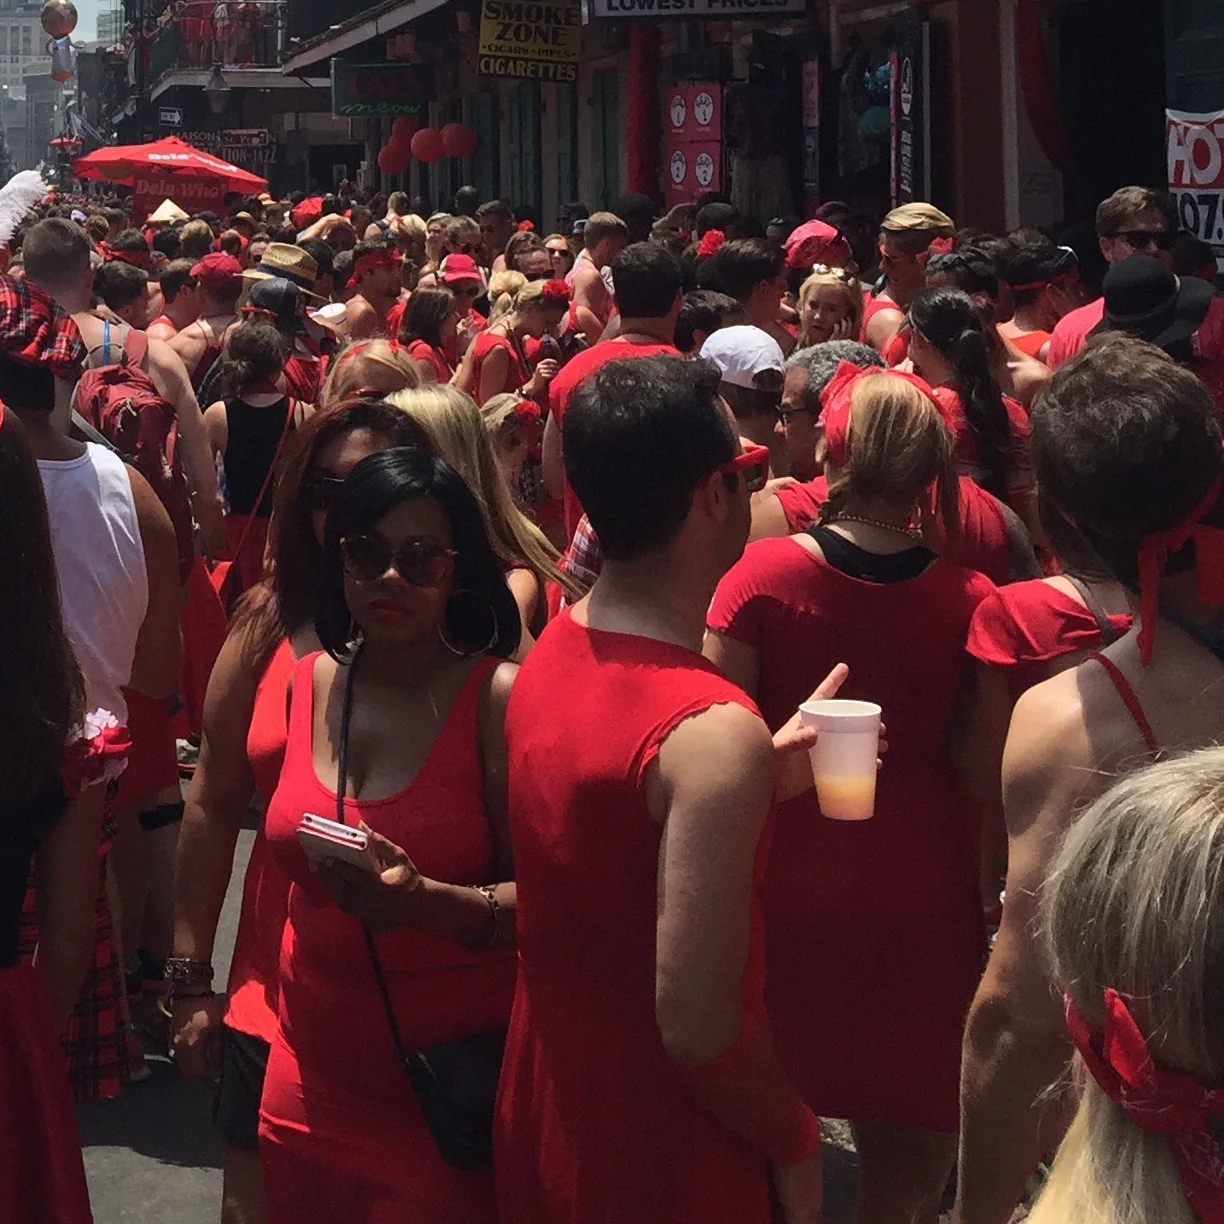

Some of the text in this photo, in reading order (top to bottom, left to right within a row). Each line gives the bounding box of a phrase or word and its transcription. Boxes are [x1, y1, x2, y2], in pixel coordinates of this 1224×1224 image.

[484, 0, 579, 26] SMOKE
[495, 21, 568, 46] ZONE
[480, 57, 577, 81] CIGARETTES
